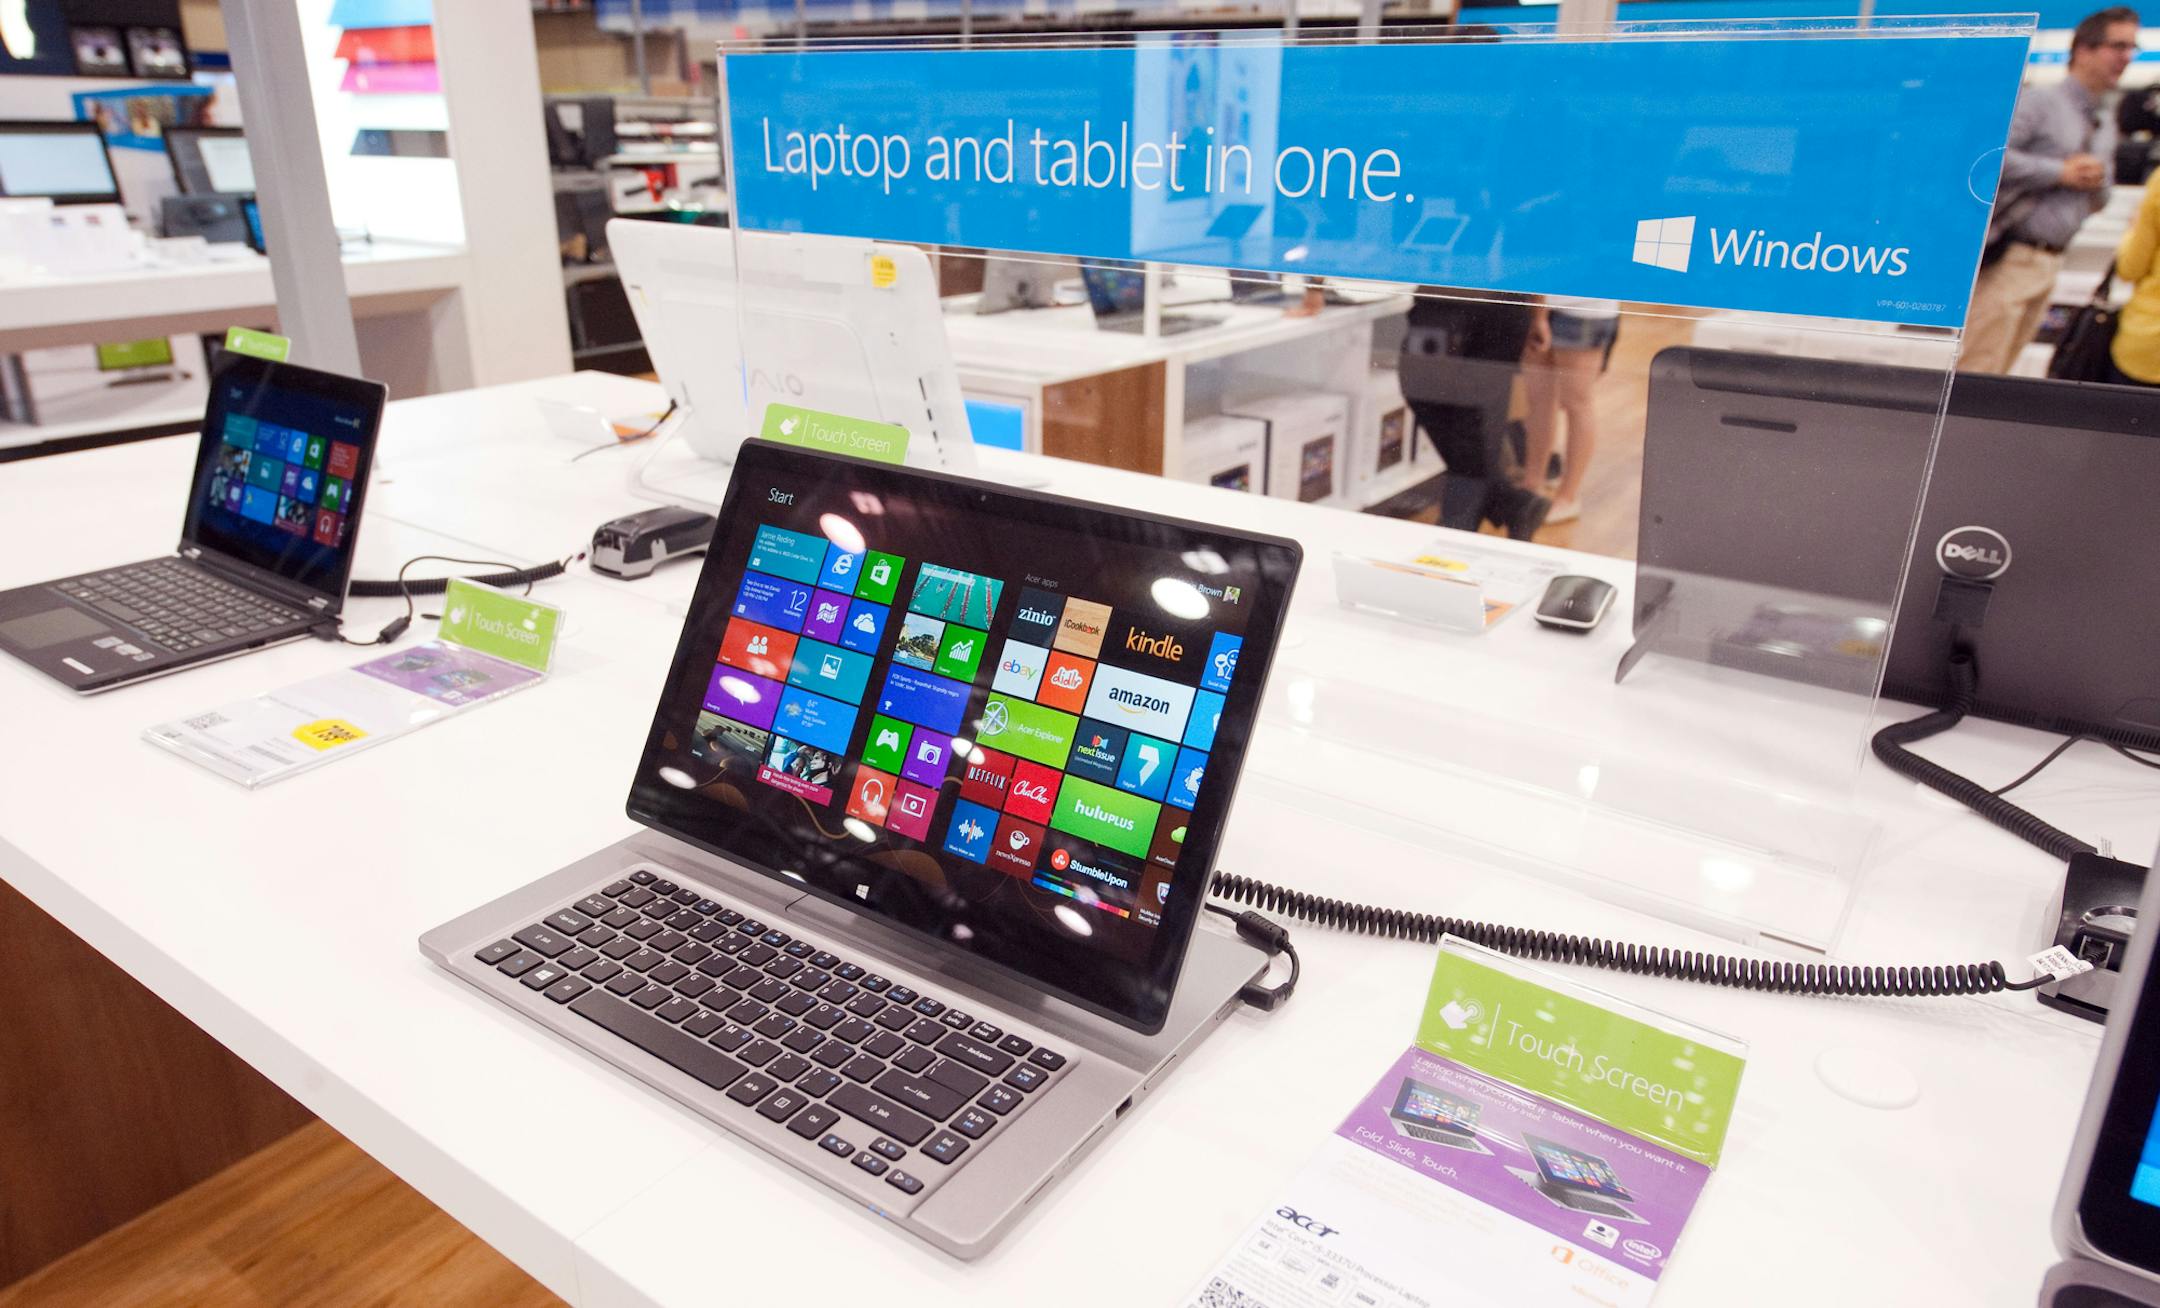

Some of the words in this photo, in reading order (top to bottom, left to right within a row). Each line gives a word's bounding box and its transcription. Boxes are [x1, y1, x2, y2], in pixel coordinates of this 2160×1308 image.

[763, 117, 910, 195] Laptop
[925, 119, 1014, 184] and
[1031, 119, 1185, 192] tablet
[1204, 126, 1253, 194] in
[1275, 146, 1415, 203] one.
[1710, 227, 1910, 277] Windows
[810, 422, 847, 446] Touch
[850, 430, 891, 455] Screen
[768, 487, 794, 506] Start
[1944, 543, 2002, 565] DELL
[1024, 573, 1041, 586] Acer
[1041, 577, 1058, 588] apps
[1199, 584, 1223, 598] Brown
[786, 588, 809, 612] 12
[1018, 607, 1054, 626] zinio
[1064, 619, 1100, 636] iCookbook
[475, 612, 504, 634] Touch
[506, 622, 541, 646] Screen
[1126, 627, 1184, 661] kindle
[1002, 659, 1038, 680] ebay
[1052, 668, 1083, 688] didlr
[1109, 687, 1170, 714] amazon
[1017, 723, 1034, 736] Acer
[1034, 727, 1065, 744] Explorer
[967, 767, 1006, 790] NETFLIX
[1014, 780, 1049, 804] ChaCha
[996, 849, 1032, 868] newsXpresso
[1070, 860, 1128, 889] StumbleUpon
[1020, 1068, 1037, 1078] Home
[1507, 1020, 1584, 1075] Touch
[1593, 1055, 1685, 1114] Screen
[1466, 1086, 1507, 1107] Powered
[1414, 1057, 1454, 1077] Laptop
[1452, 1072, 1482, 1087] when
[1549, 1111, 1587, 1130] Tablet
[1585, 1125, 1620, 1144] when
[1616, 1140, 1644, 1156] you
[1643, 1151, 1674, 1168] want
[1673, 1162, 1691, 1175] it.
[1354, 1125, 1387, 1145] Fold.
[1383, 1139, 1421, 1161] Slide.
[1417, 1154, 1463, 1181] Touch.
[1276, 1206, 1340, 1237] acer
[1578, 1258, 1629, 1289] Office
